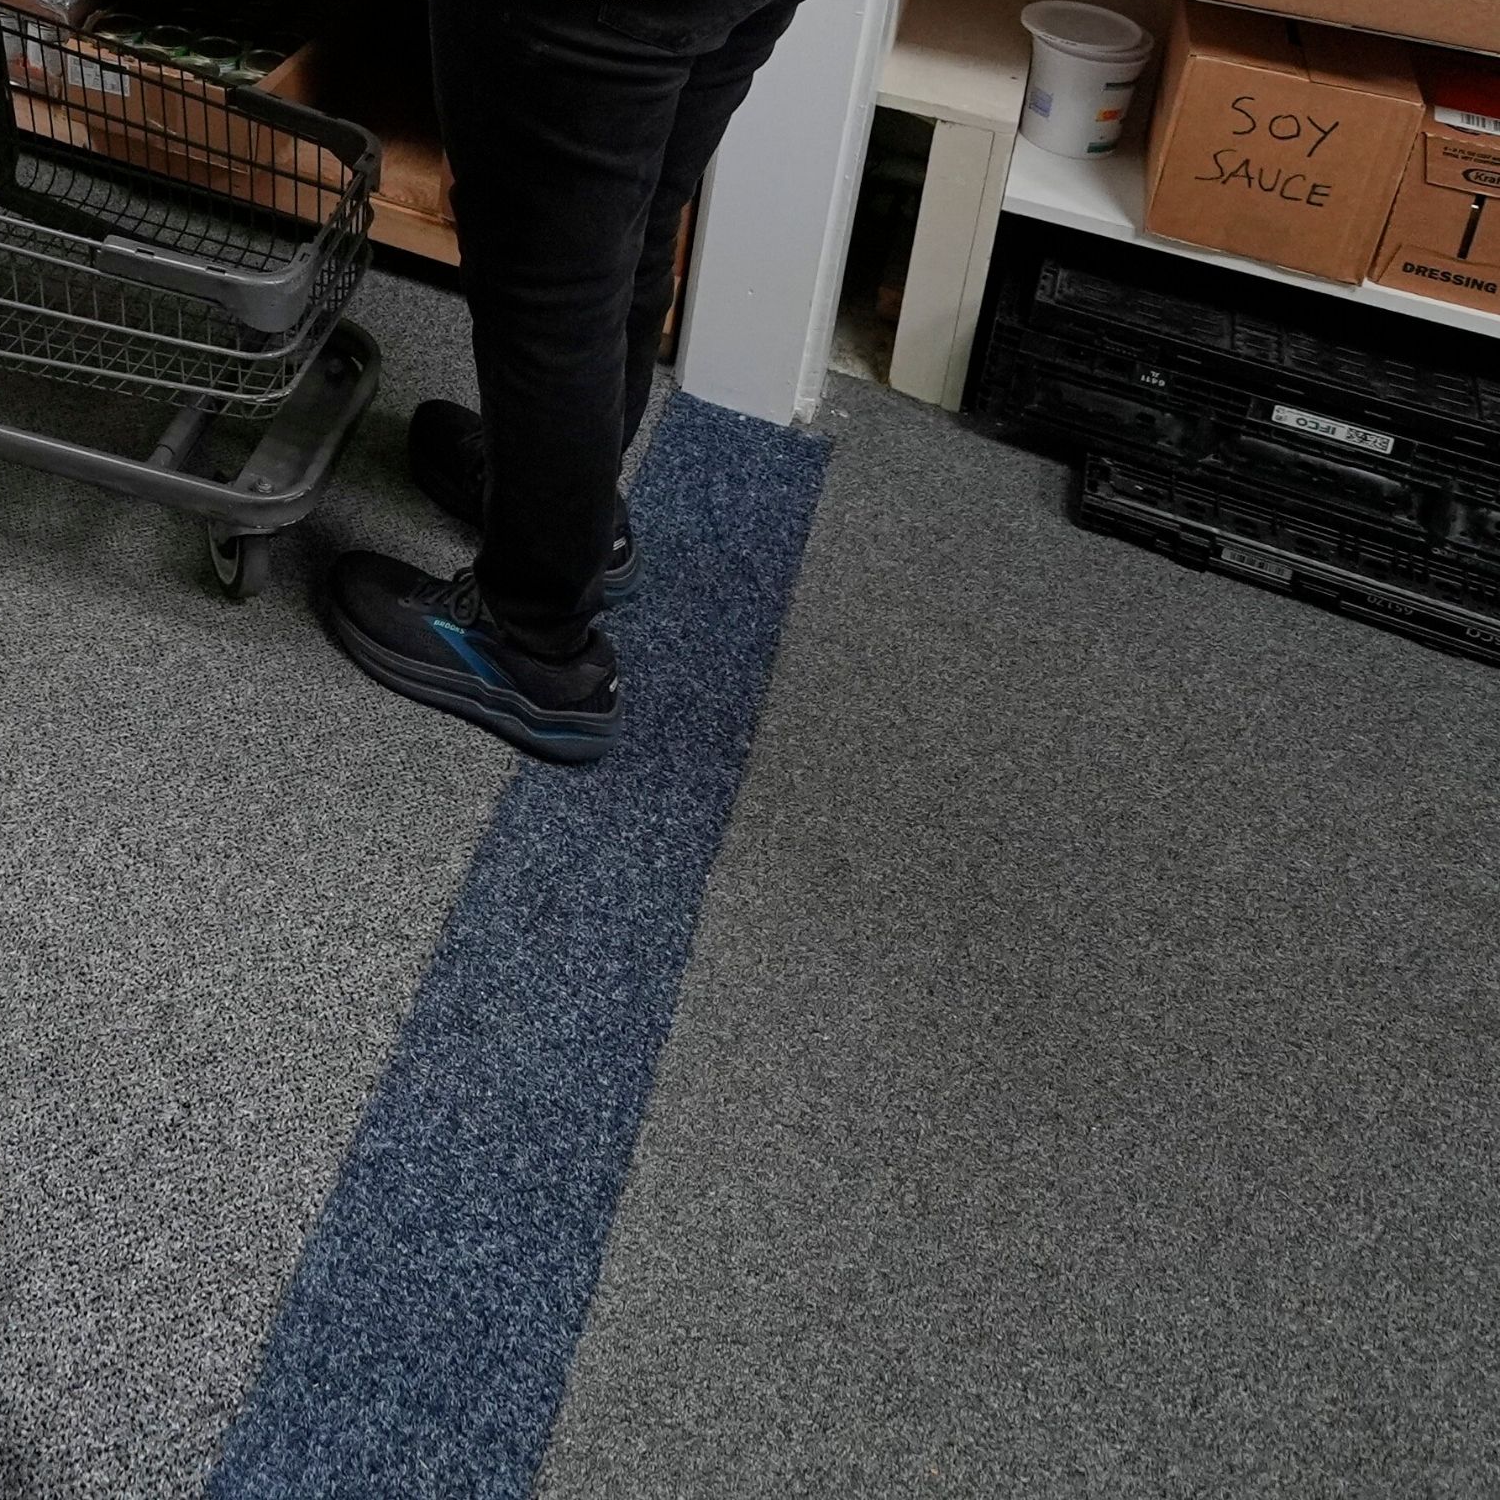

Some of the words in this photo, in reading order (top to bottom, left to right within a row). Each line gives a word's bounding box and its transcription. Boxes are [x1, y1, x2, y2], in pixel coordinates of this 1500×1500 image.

[1231, 96, 1340, 158] SOY
[1195, 149, 1331, 207] SAUCE
[1401, 261, 1498, 295] DRESSING
[1296, 416, 1337, 437] IFCO
[433, 619, 466, 635] BROOKS
